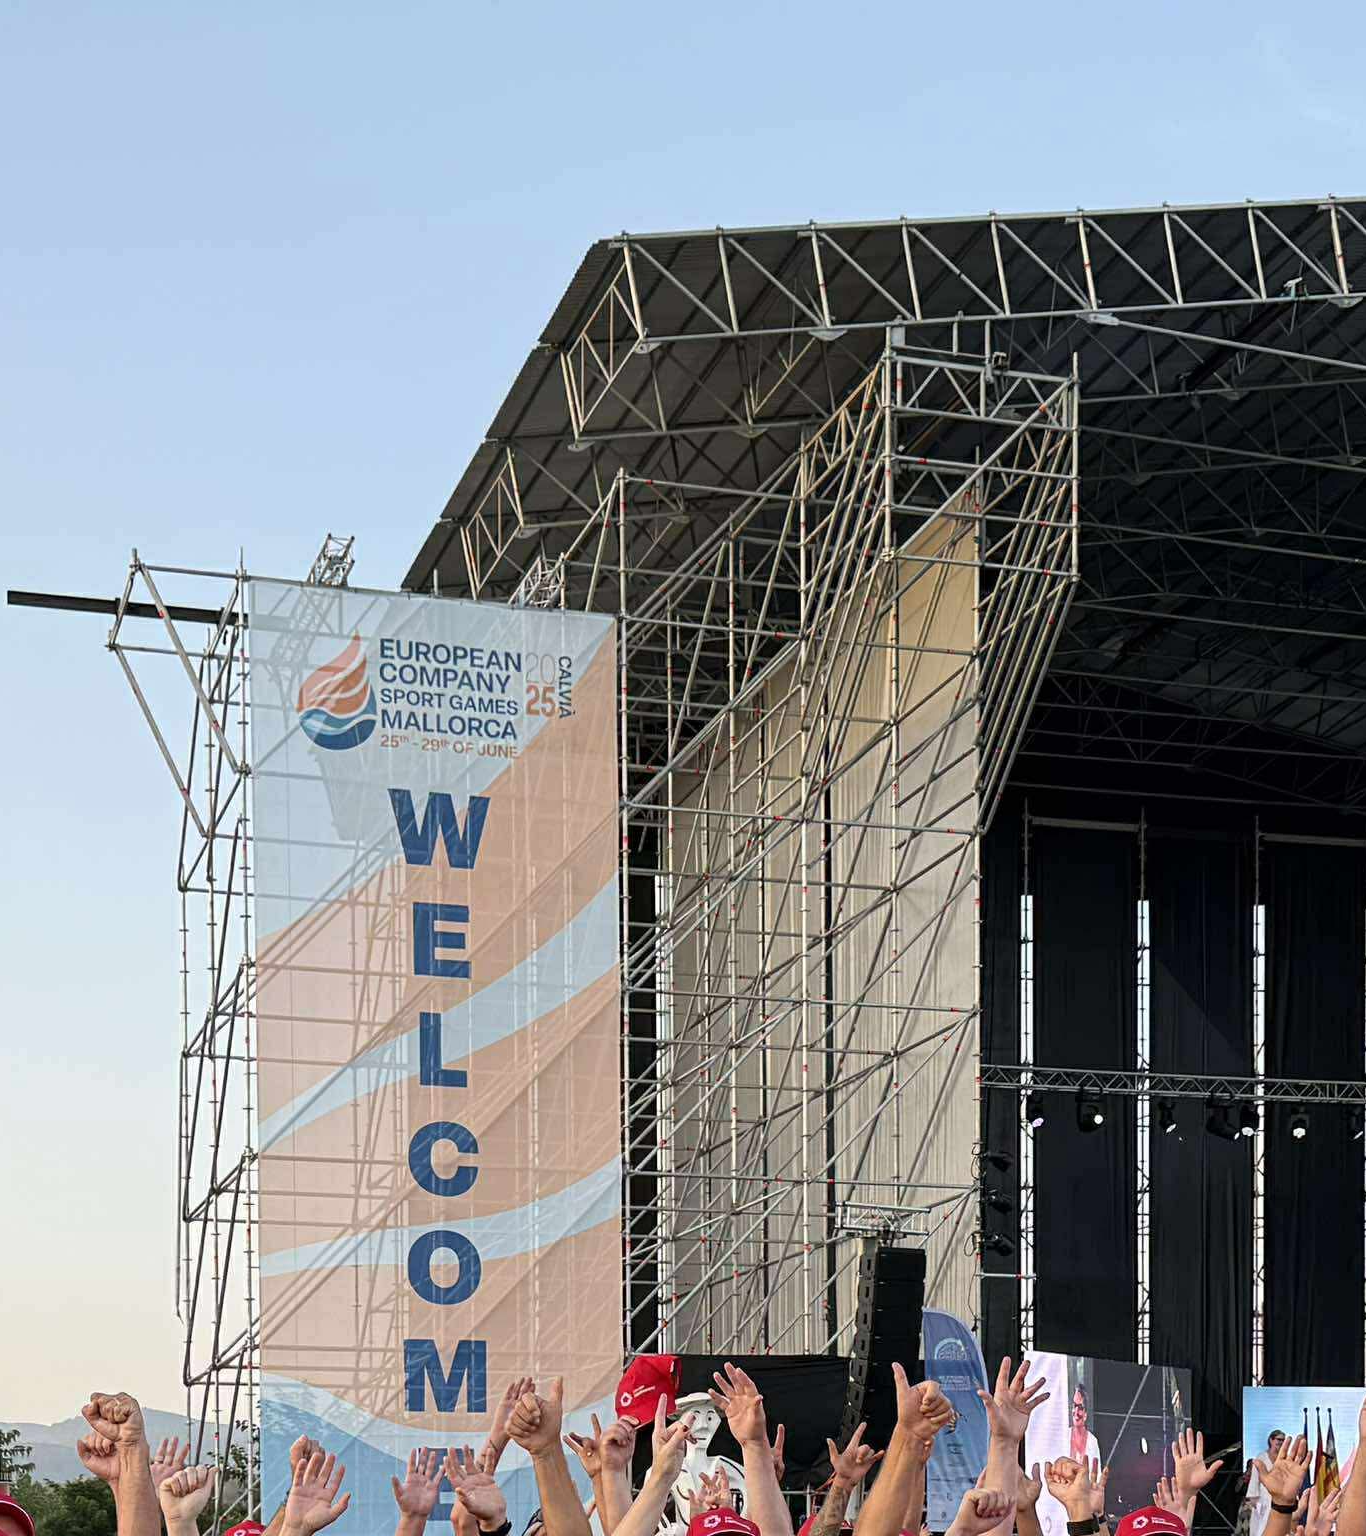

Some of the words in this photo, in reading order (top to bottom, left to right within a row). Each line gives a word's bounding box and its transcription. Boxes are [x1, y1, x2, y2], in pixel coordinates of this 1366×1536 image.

[380, 638, 522, 673] EUROPEAN
[525, 652, 556, 685] 20
[379, 662, 511, 694] COMPANY
[380, 688, 445, 709] SPORT
[449, 695, 519, 716] GAMES
[525, 684, 557, 718] 25
[381, 709, 517, 740] MALLORCA
[453, 740, 474, 754] OF
[477, 743, 520, 759] JUNE
